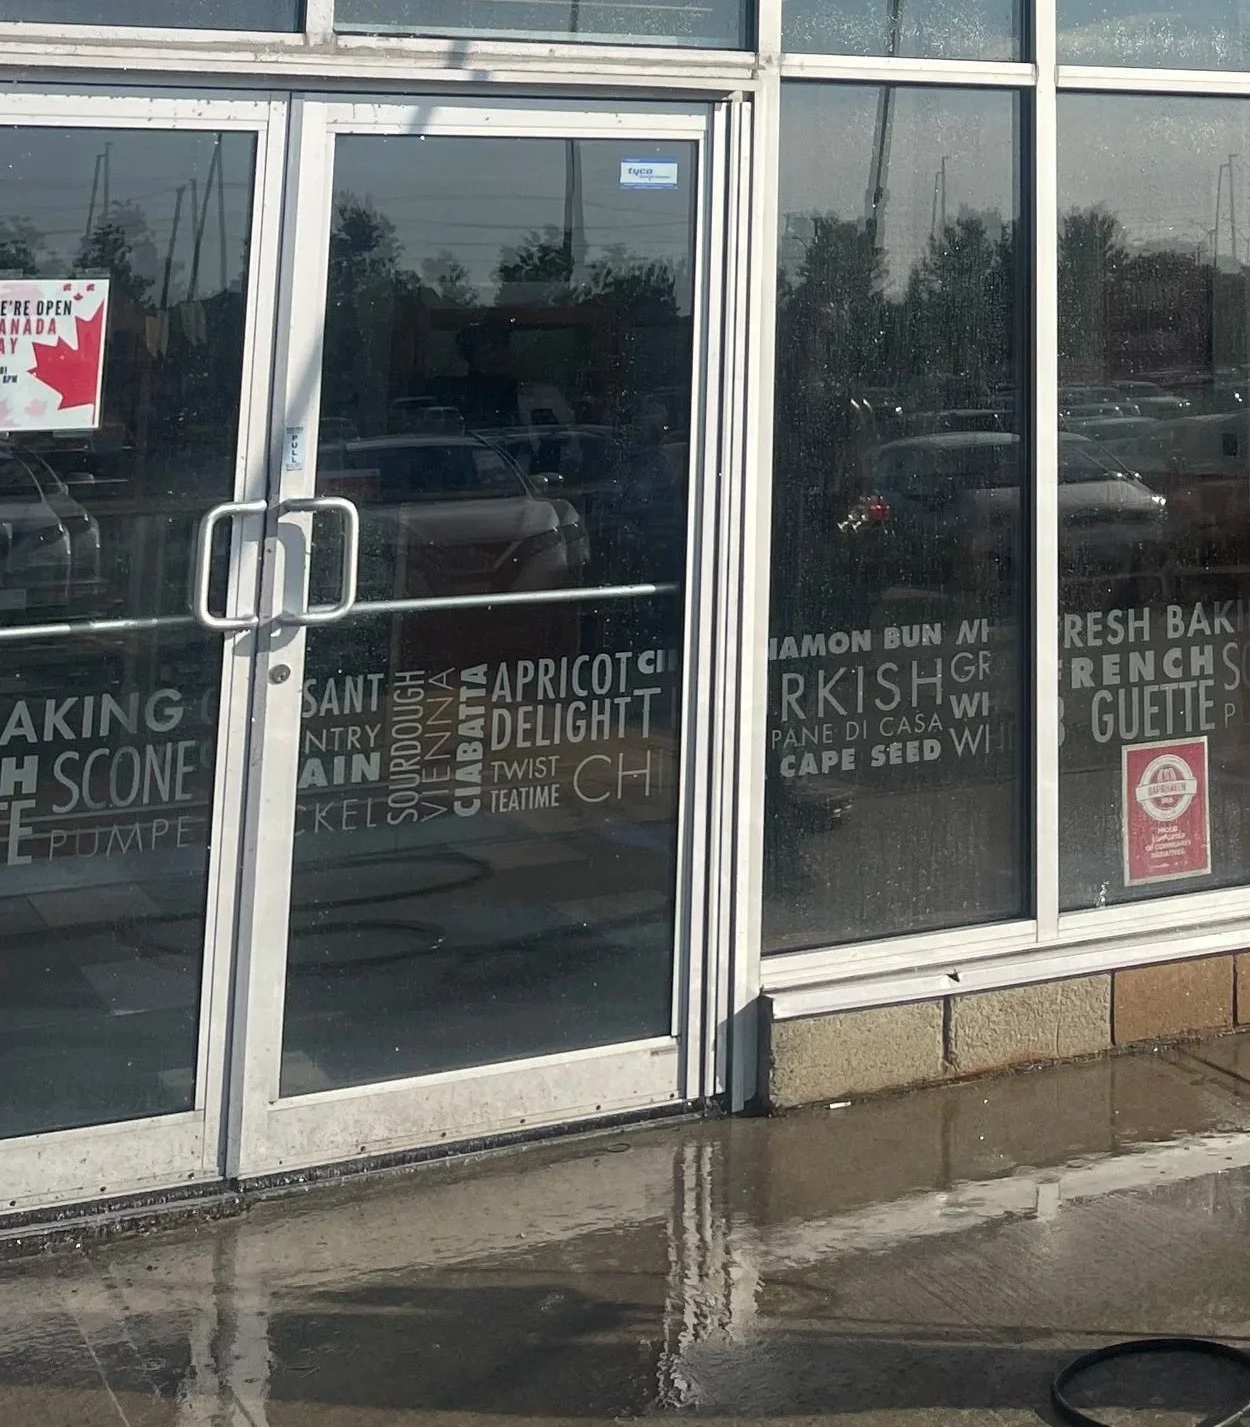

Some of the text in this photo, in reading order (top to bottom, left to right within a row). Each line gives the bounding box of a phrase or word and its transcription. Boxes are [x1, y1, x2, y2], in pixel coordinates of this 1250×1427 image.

[36, 300, 72, 316] OPEN
[884, 623, 942, 650] BUN
[1058, 607, 1150, 649] RESH
[491, 651, 633, 702] APRICOT
[1058, 644, 1214, 689] RENCH
[302, 673, 384, 719] SANT
[781, 658, 943, 722] RKISH
[0, 688, 184, 746] AKING
[305, 723, 381, 755] NTRY
[491, 696, 632, 751] DELIGHT
[772, 712, 943, 749] PANE DI CASA
[386, 670, 426, 825] SOURDOUGH
[420, 667, 456, 822] VIENNA
[453, 663, 489, 817] CIABATTA
[780, 738, 942, 778] CAPE SEED
[52, 740, 196, 814] SCONE
[298, 751, 381, 789] AIN
[490, 755, 560, 783] TWIST
[490, 784, 560, 814] TEATIME
[50, 815, 192, 861] PUMPE
